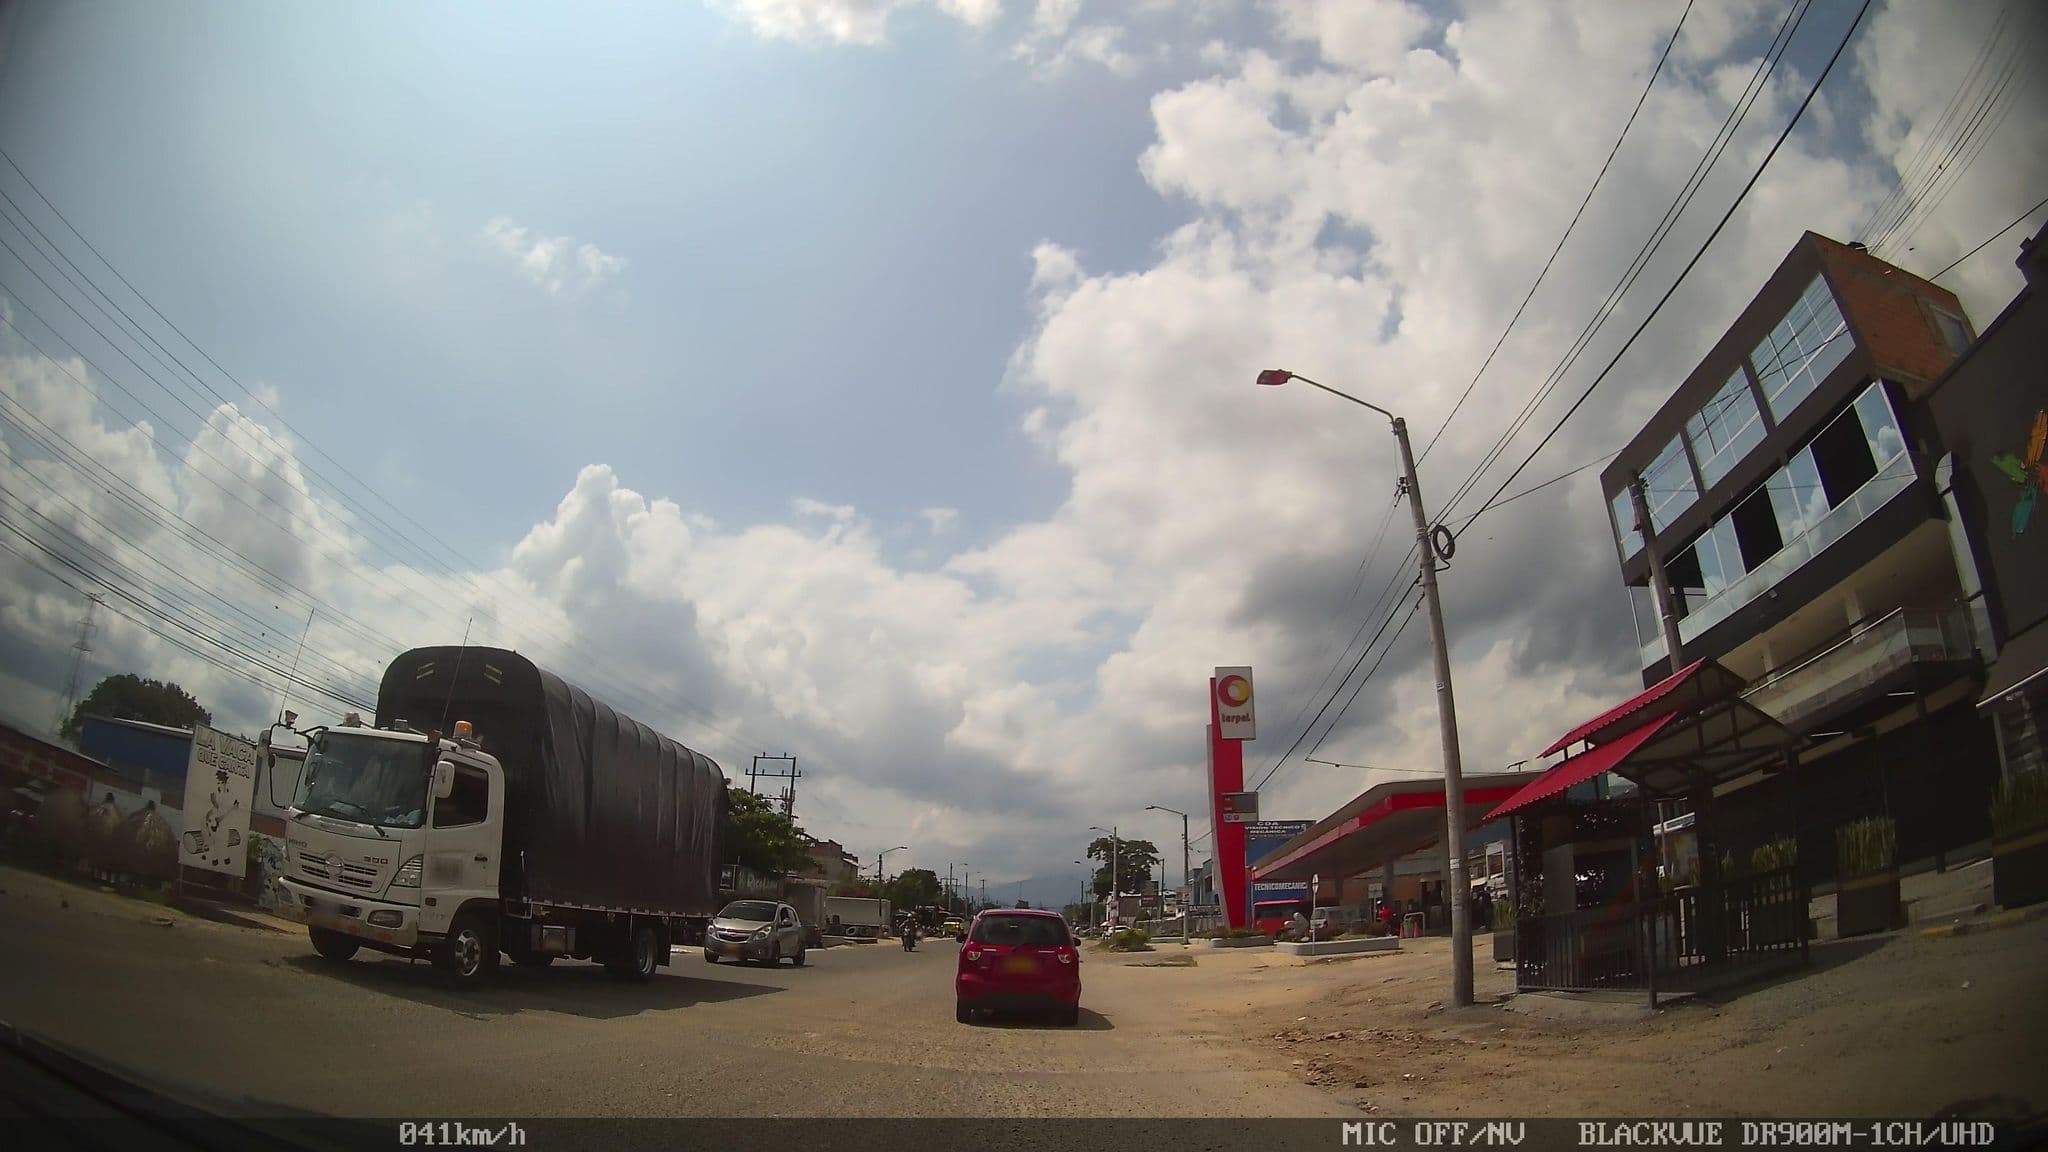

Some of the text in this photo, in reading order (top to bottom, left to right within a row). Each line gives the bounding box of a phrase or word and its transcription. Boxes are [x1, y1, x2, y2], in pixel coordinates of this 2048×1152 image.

[1222, 713, 1251, 724] terpel
[196, 727, 255, 766] LA VACA
[198, 748, 251, 779] QUE CANTA
